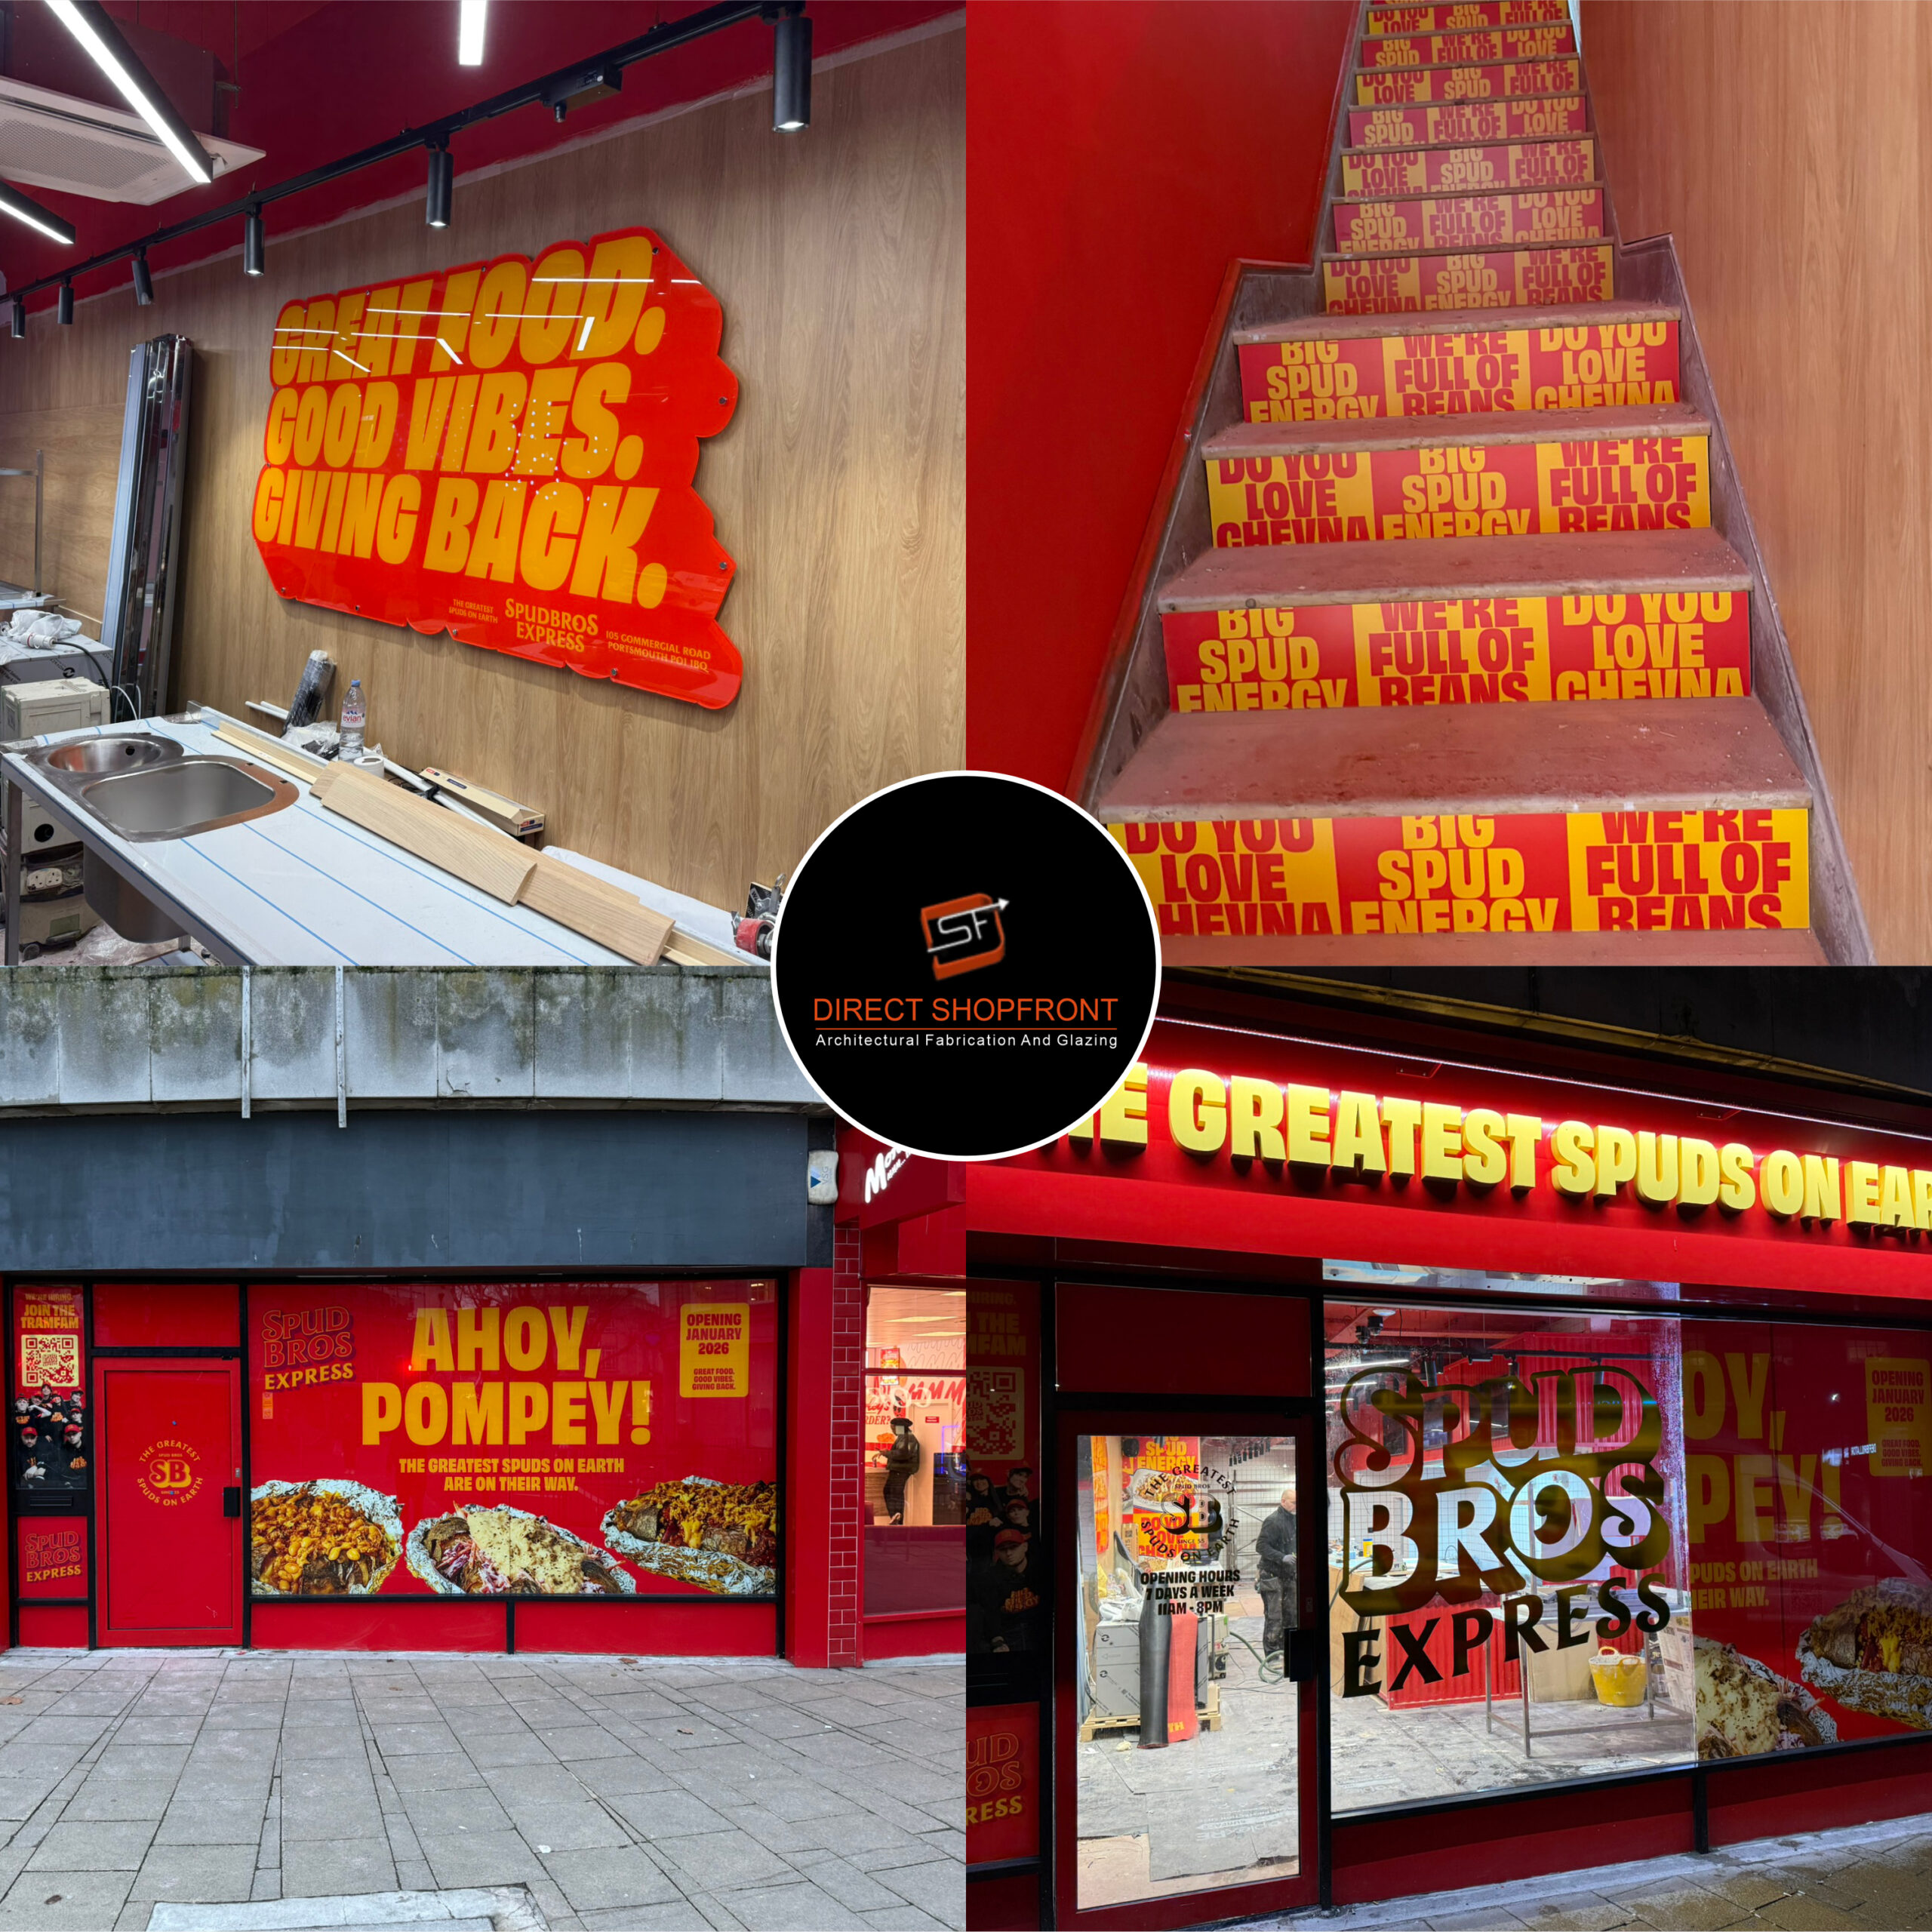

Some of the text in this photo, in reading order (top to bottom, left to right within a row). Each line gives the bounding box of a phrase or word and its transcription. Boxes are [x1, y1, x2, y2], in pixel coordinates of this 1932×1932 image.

[1374, 84, 1415, 103] LOVE
[1444, 78, 1491, 100] SPUD
[1510, 72, 1574, 94] FULL OF
[1350, 217, 1407, 241] SPUD
[1429, 211, 1506, 235] FULL OF
[1532, 205, 1583, 229] LOVE
[1345, 275, 1399, 299] LOVE
[1437, 269, 1497, 294] SPUD
[1523, 262, 1606, 289] FULL OF
[272, 235, 666, 385] GREAT FOOD.
[1394, 353, 1519, 393] FULL OF
[1562, 346, 1646, 385] LOVE
[1266, 362, 1358, 400] SPUD
[266, 362, 644, 481] GOOD VIBES.
[1419, 446, 1486, 475] BIG
[1402, 471, 1506, 513] SPUD
[1550, 463, 1697, 506] FULL OF
[1245, 479, 1337, 521] LOVE
[254, 468, 667, 609] GIVING BACK.
[449, 606, 498, 623] SPUDS ON EARTH
[453, 599, 494, 614] THE GREATEST
[505, 598, 599, 635] SPUDBROS
[1380, 598, 1519, 632] WERE
[516, 620, 585, 653] EXPRESS
[1217, 607, 1294, 639] BIG
[606, 630, 712, 661] 105 COMMERCIAL ROAD
[608, 641, 668, 663] PORTSMOUTH
[1198, 636, 1319, 684] SPUD
[1368, 627, 1534, 676] FULL OF
[1592, 623, 1705, 669] LOVE
[343, 713, 363, 723] evian
[1401, 814, 1494, 850] BIG
[1601, 809, 1773, 844] WERE
[1160, 853, 1287, 903] LOVE
[1377, 848, 1524, 900] SPUD
[1586, 842, 1791, 896] FULL OF
[1158, 902, 1334, 936] HEVNA
[1168, 1069, 1541, 1191] GREATEST
[1552, 1121, 1757, 1212] SPUDS
[1760, 1150, 1841, 1222] ON
[1844, 1161, 1932, 1232] EAR
[820, 1166, 829, 1185] VSG
[20, 1316, 79, 1329] TRAMFAM
[24, 1304, 75, 1316] JOIN THE
[262, 1306, 350, 1341] SPUD
[687, 1313, 742, 1326] OPENING
[411, 1306, 602, 1379] AHOY,
[686, 1327, 743, 1340] JANUARY
[263, 1331, 353, 1367] BROS
[698, 1342, 729, 1355] 2026
[265, 1362, 354, 1390] EXPRESS
[1872, 1370, 1924, 1386] OPENING
[1682, 1350, 1786, 1452] OY,
[1872, 1389, 1924, 1404] JANUARY
[362, 1380, 651, 1445] POMPEY!
[1884, 1407, 1914, 1422] 2026
[1334, 1366, 1654, 1489] SPUD
[139, 1440, 201, 1463] THE GREATEST
[1137, 1456, 1196, 1471] ENERGY
[1146, 1441, 1187, 1457] SPUD
[1882, 1449, 1900, 1457] GOOD
[149, 1459, 192, 1488] SB
[399, 1457, 625, 1474] THE GREATEST SPUDS ON EARTH
[137, 1478, 161, 1503] SPUDS
[180, 1477, 204, 1503] EARTH
[444, 1476, 579, 1492] ARE ON THEIR WAY.
[1145, 1464, 1236, 1497] THE GREATEST
[1684, 1454, 1841, 1543] PEY!
[24, 1531, 79, 1552] SPUD
[1141, 1518, 1240, 1562] SPUDS ON EARTH
[1343, 1463, 1660, 1598] BROS
[26, 1546, 81, 1568] BROS
[1689, 1558, 1818, 1584] PUDS ON EARTH
[26, 1564, 81, 1583] EXPRESS
[1140, 1570, 1241, 1585] OPENING HOURS
[1146, 1585, 1235, 1600] 7 DAYS A WEEK
[1690, 1586, 1769, 1611] EIR WAY.
[1158, 1602, 1187, 1615] 11AM
[1197, 1601, 1223, 1614] 8PM
[1342, 1574, 1671, 1699] EXPRESS
[966, 1733, 1019, 1769] UD
[966, 1761, 1022, 1797] OS
[966, 1795, 1023, 1826] RESS
